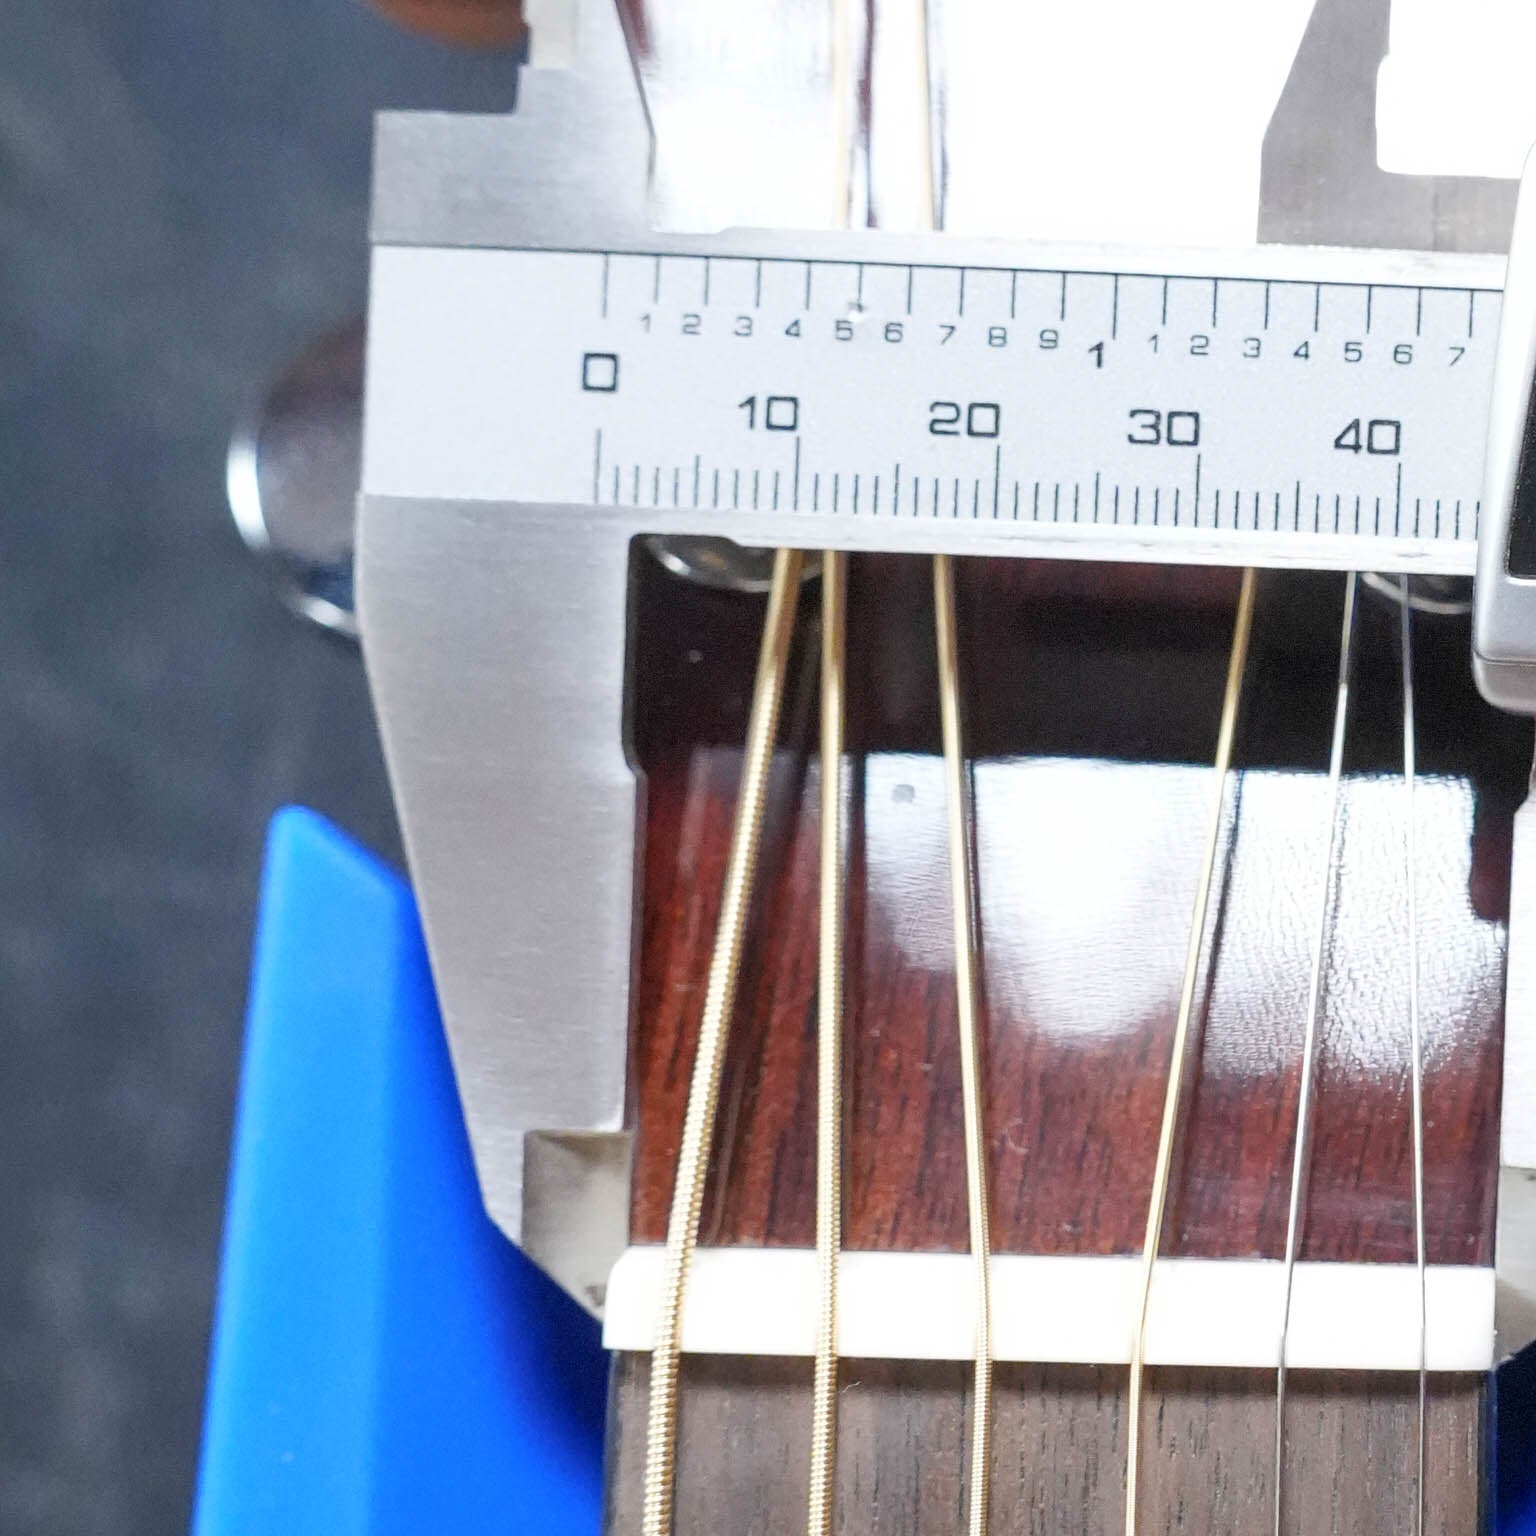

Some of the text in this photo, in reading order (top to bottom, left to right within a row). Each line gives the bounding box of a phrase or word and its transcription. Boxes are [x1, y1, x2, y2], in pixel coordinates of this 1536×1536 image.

[637, 311, 1467, 370] 1 2 3 4 5 6 7 8 9 1 1 2 3 4 5 6 7
[580, 351, 1403, 458] 0 10 20 30 40
